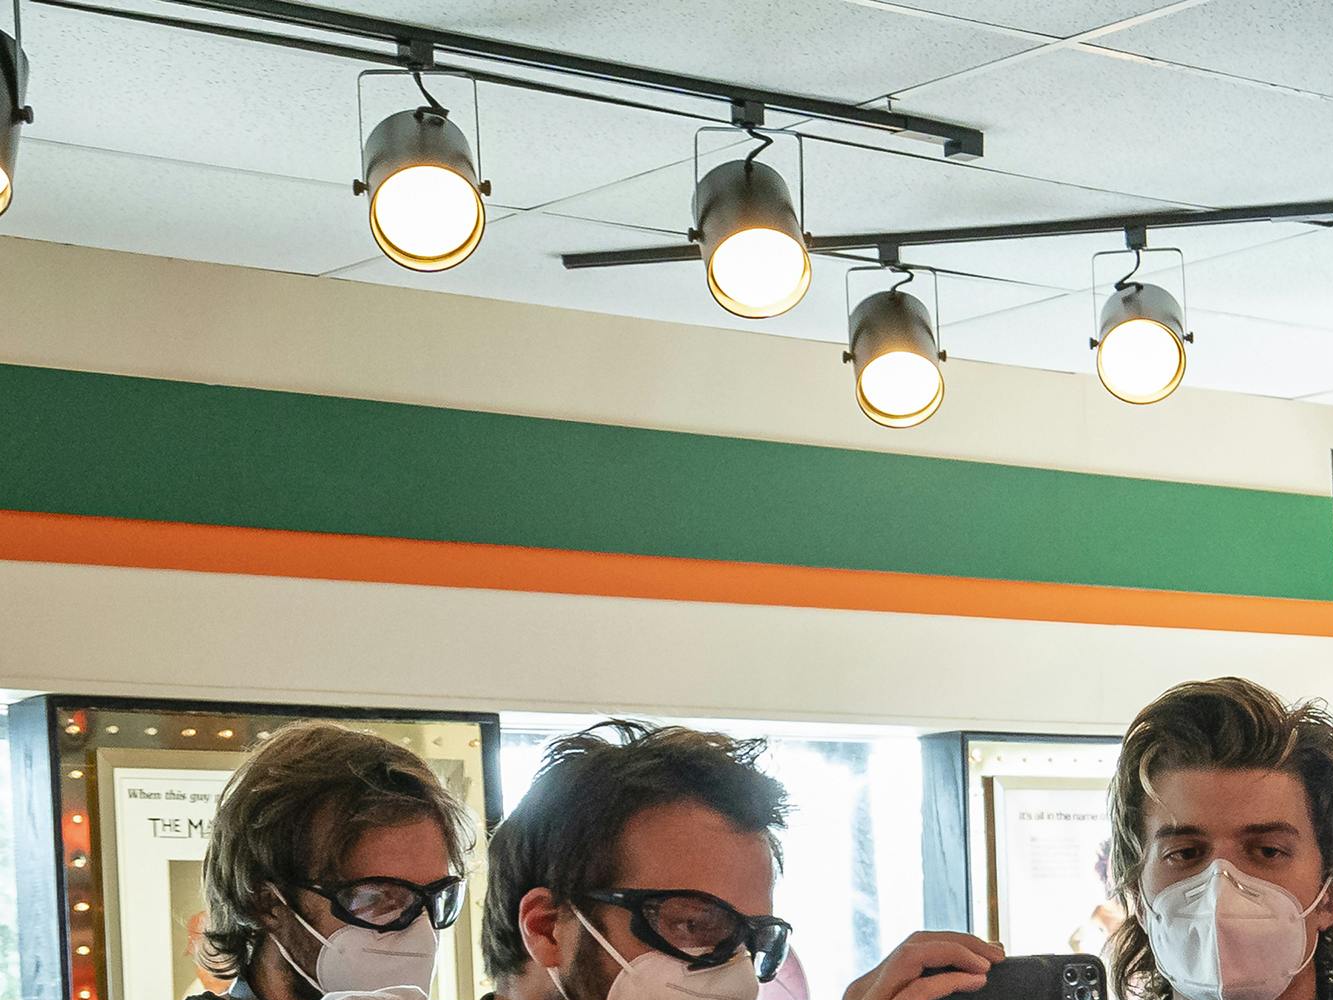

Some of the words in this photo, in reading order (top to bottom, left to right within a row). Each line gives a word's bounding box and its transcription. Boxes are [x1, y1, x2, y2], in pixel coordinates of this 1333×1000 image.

[127, 788, 161, 800] When
[164, 789, 187, 801] this
[189, 793, 210, 803] guy
[1056, 811, 1071, 821] the
[147, 818, 181, 838] THE
